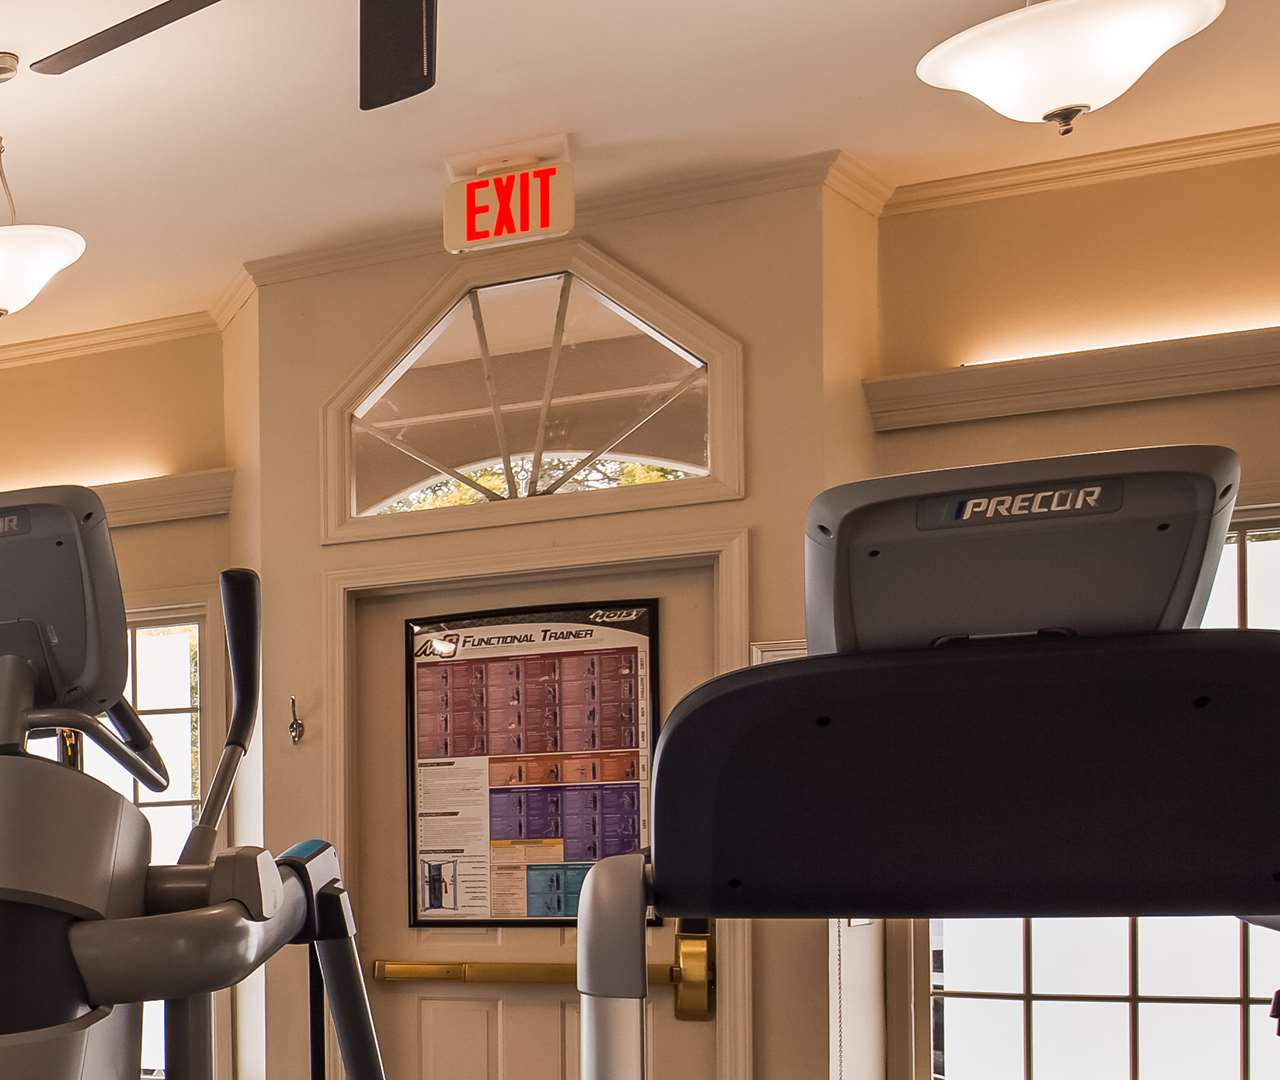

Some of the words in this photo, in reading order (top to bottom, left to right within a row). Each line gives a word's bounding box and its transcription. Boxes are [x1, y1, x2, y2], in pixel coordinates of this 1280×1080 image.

[465, 166, 557, 242] EXIT
[961, 485, 1103, 521] PRECOR
[461, 633, 536, 648] FUNCTIONAL
[541, 628, 594, 643] TRAINER
